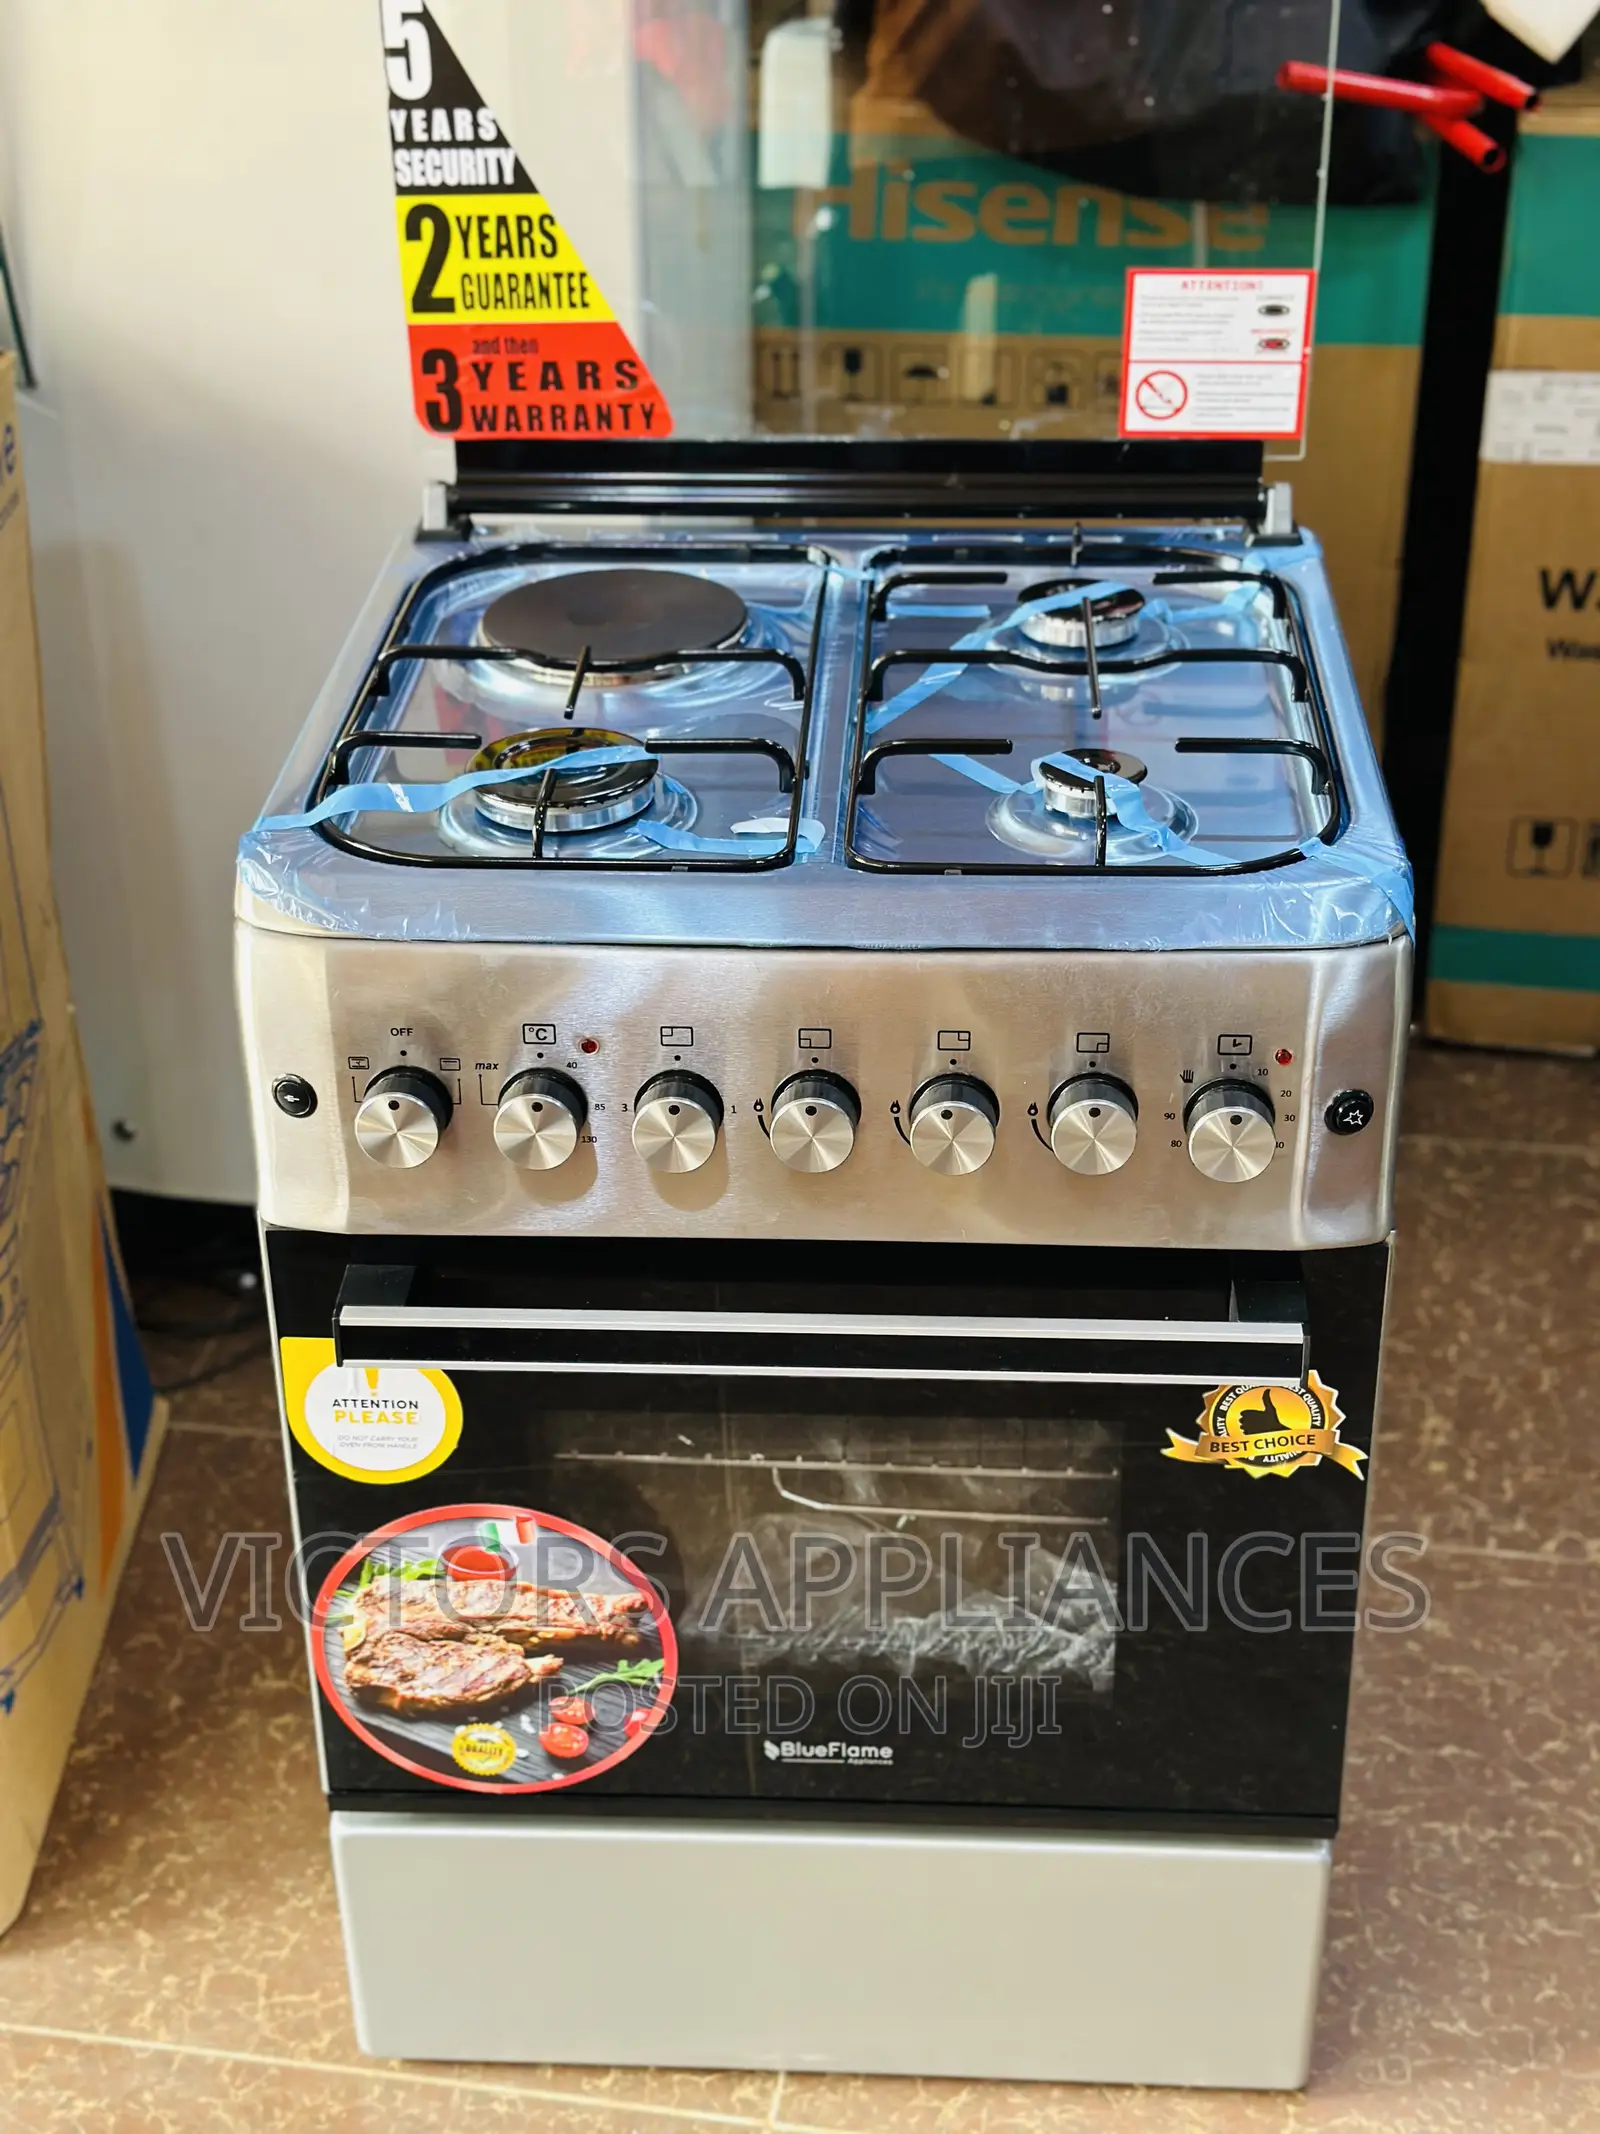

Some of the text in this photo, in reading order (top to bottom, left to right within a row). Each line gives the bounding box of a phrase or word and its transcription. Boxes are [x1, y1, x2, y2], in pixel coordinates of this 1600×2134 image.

[380, 0, 433, 100] 5
[389, 108, 498, 142] YEARS
[393, 147, 517, 187] SECURITY
[792, 157, 1269, 252] Hisense
[405, 203, 559, 314] 2 YEARS
[460, 272, 590, 311] GUARANTEE
[472, 336, 539, 354] and then
[421, 348, 639, 433] 3 YEARS
[471, 402, 656, 432] WARRANTY
[1537, 567, 1600, 612] W
[390, 1027, 414, 1037] OFF
[474, 1061, 499, 1071] max
[566, 1061, 578, 1070] 40
[1258, 1068, 1269, 1076] 10
[1280, 1090, 1292, 1098] 20
[594, 1103, 606, 1111] 85
[621, 1104, 628, 1112] 3
[731, 1105, 737, 1114] 1
[1164, 1112, 1176, 1121] 90
[1284, 1114, 1296, 1122] 30
[581, 1136, 598, 1144] 130
[1170, 1139, 1182, 1148] 80
[332, 1398, 419, 1409] ATTENTION
[1219, 1392, 1237, 1411] BEST
[335, 1410, 419, 1425] PLEASE
[1302, 1393, 1322, 1427] QUALITY
[1210, 1434, 1315, 1453] BEST CHOICE
[780, 1741, 893, 1758] BlueFlame
